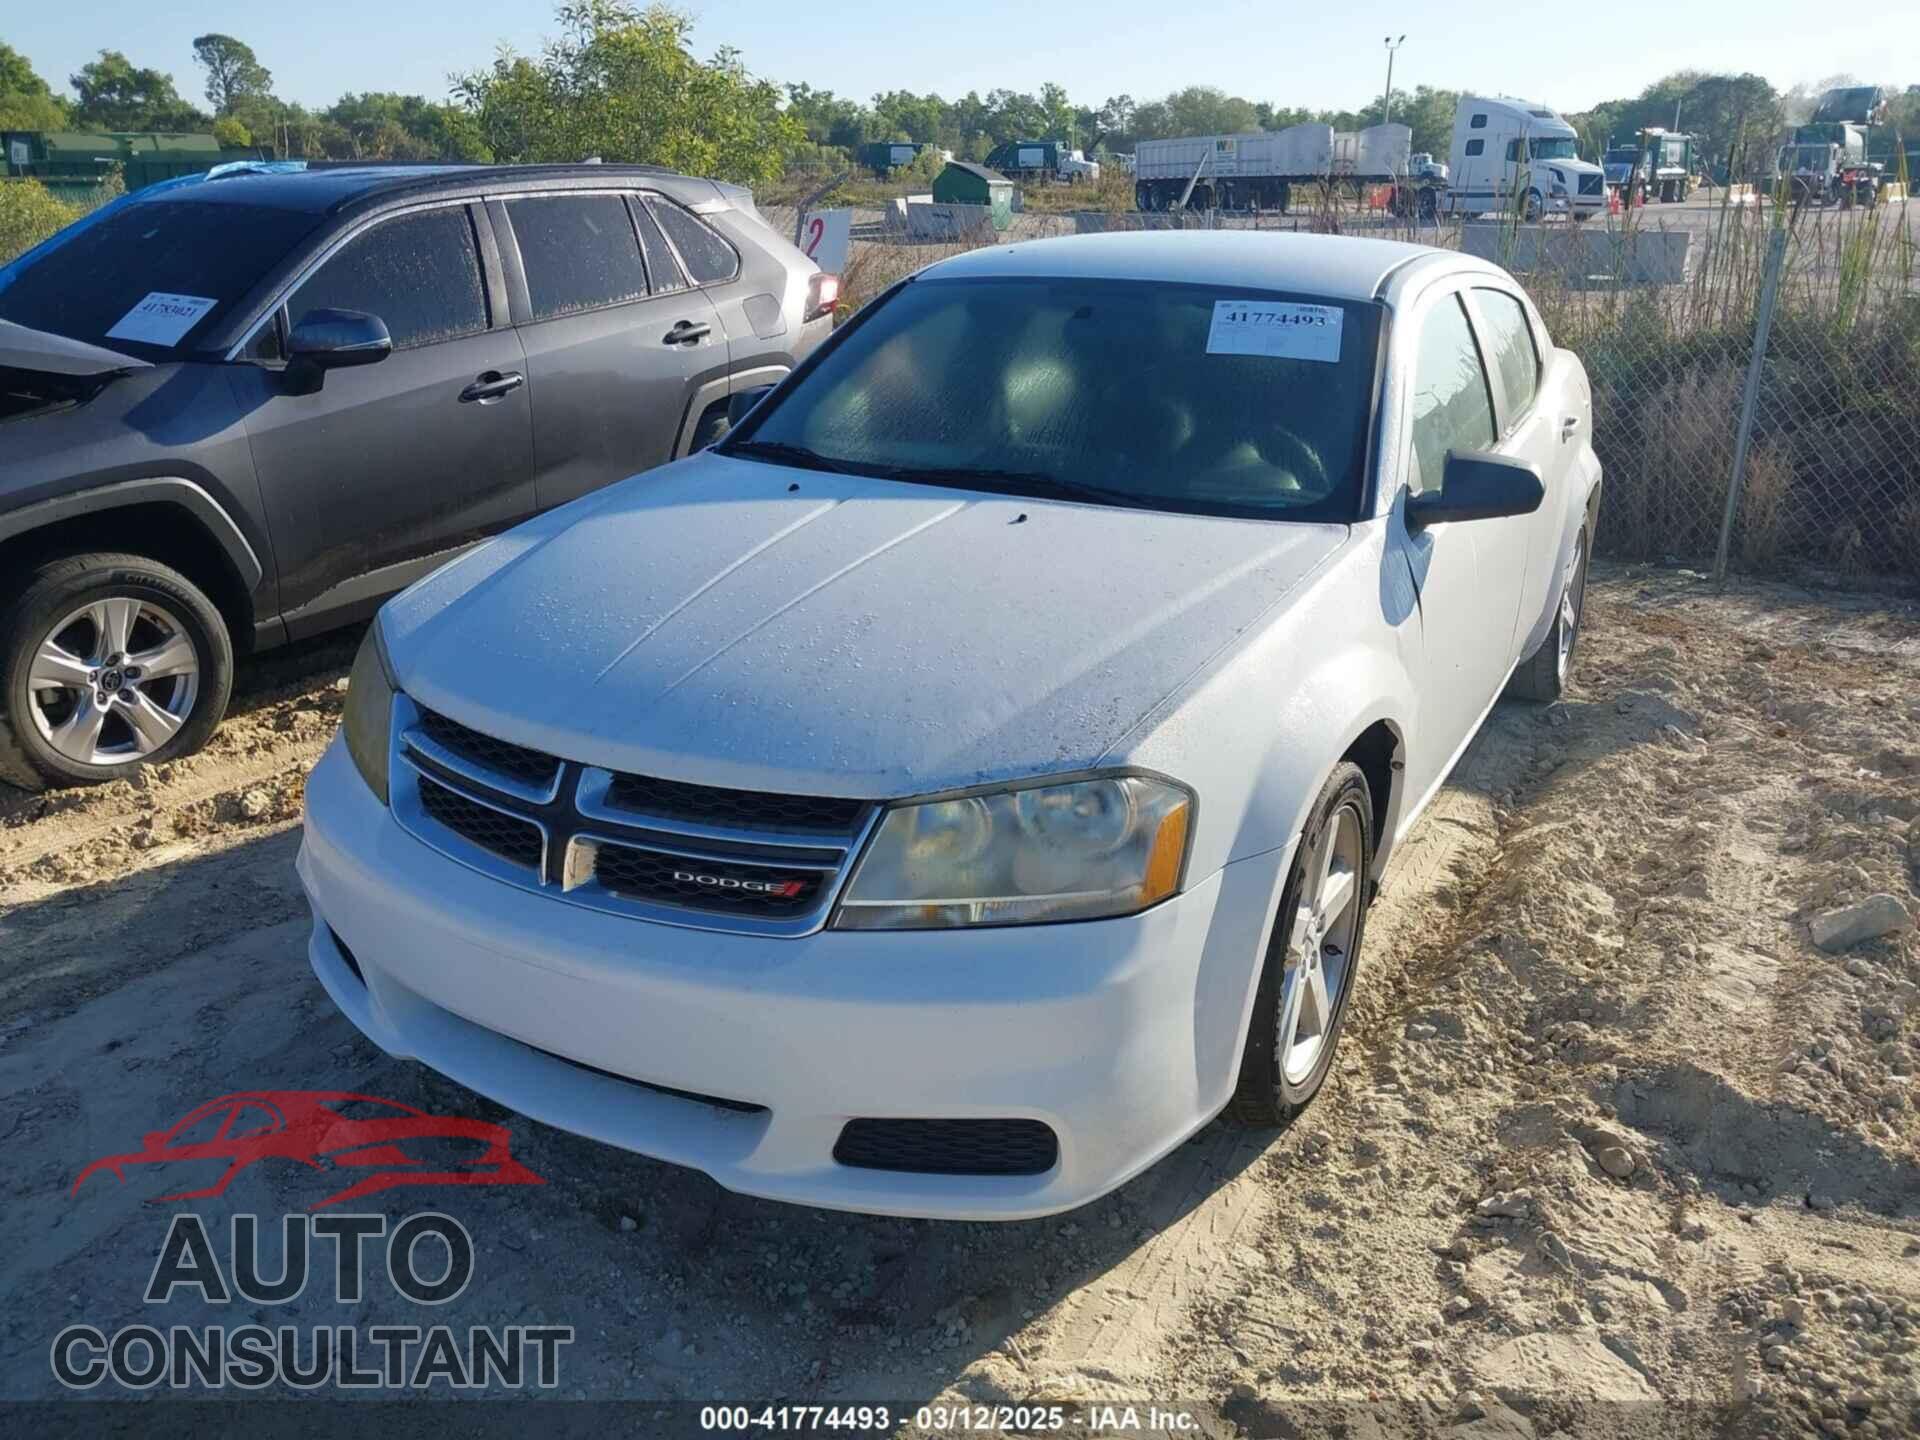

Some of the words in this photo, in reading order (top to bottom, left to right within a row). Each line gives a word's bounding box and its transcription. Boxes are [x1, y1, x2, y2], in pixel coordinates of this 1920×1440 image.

[806, 218, 824, 263] 2
[1225, 311, 1326, 327] 41774493
[674, 871, 785, 893] DODGE
